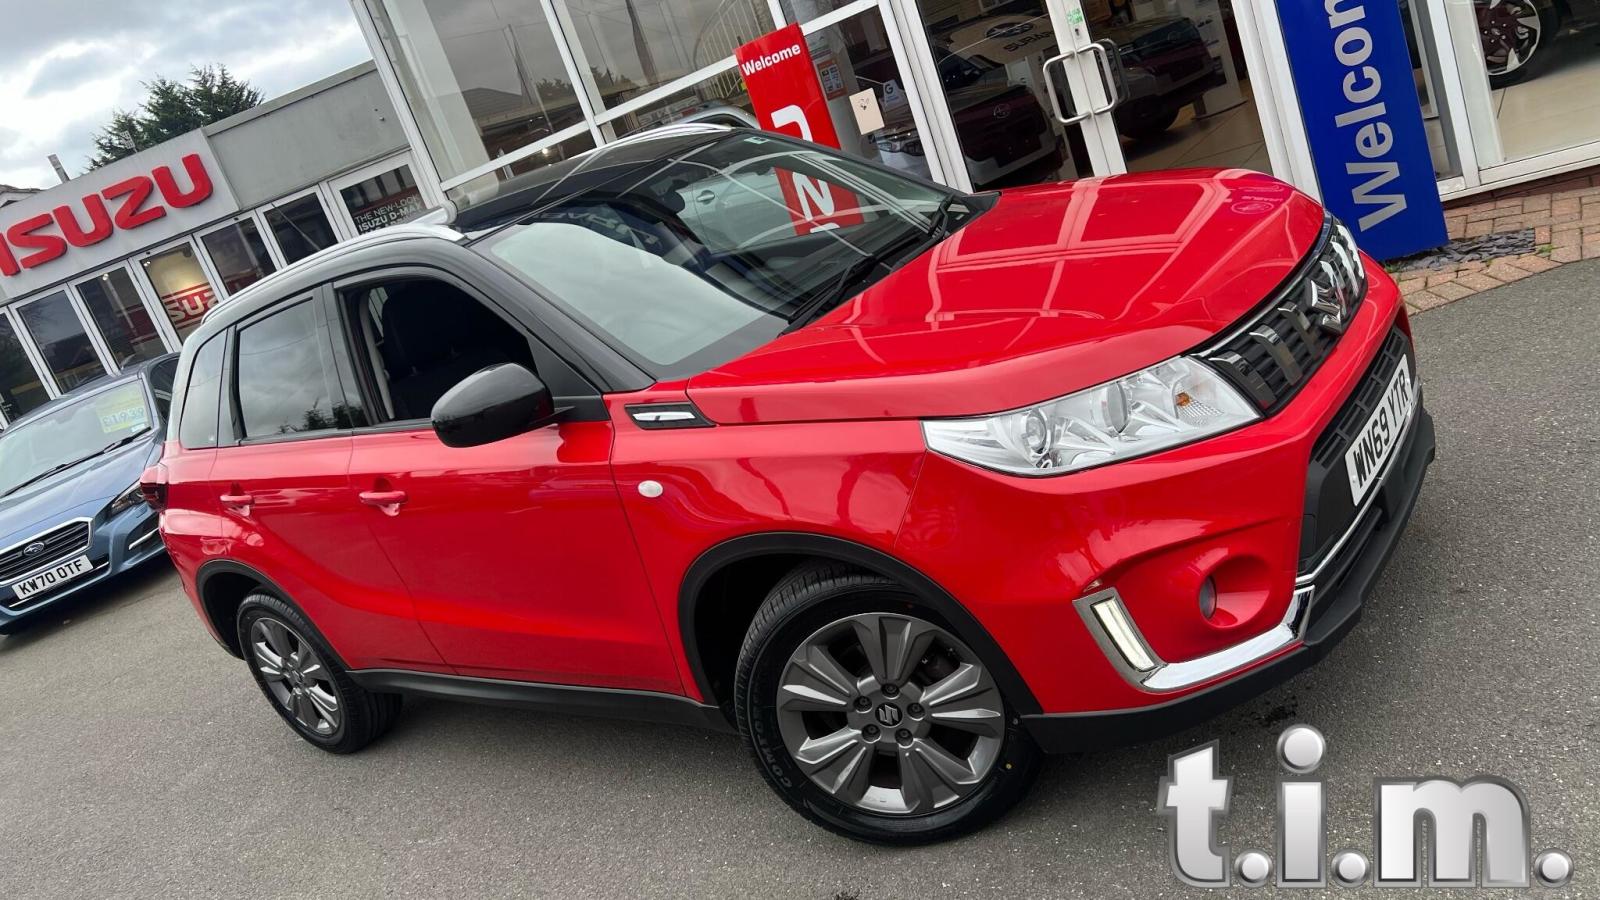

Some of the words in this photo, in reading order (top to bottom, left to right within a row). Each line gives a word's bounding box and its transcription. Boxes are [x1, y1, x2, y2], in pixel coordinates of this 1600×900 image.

[741, 43, 801, 76] Welcome
[0, 153, 214, 277] ISUZU
[354, 211, 374, 224] THE
[358, 215, 388, 232] ISUZU
[1353, 406, 1390, 489] WN69
[1387, 368, 1409, 428] YTR
[18, 572, 56, 594] KW70
[56, 560, 82, 578] OTF
